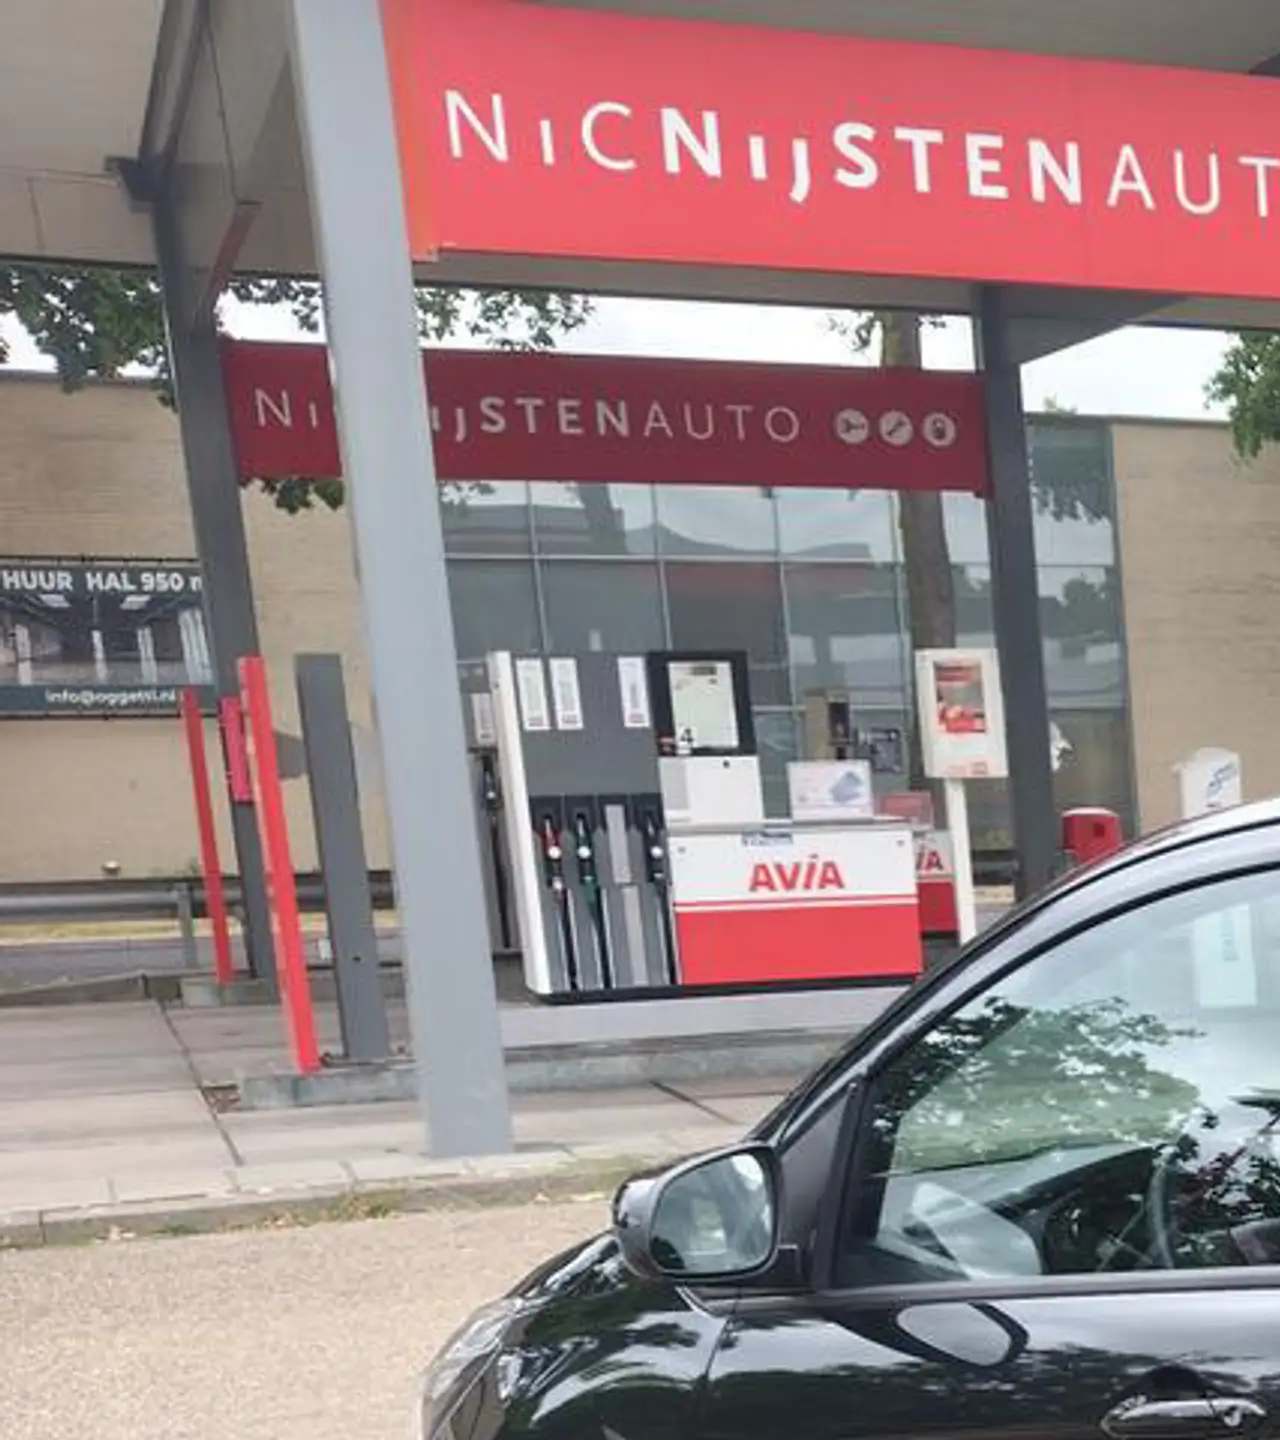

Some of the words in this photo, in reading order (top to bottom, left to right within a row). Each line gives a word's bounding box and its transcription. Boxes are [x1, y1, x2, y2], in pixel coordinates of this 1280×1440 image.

[3, 570, 73, 591] HUUR
[86, 571, 136, 591] HAL
[141, 572, 185, 592] 950
